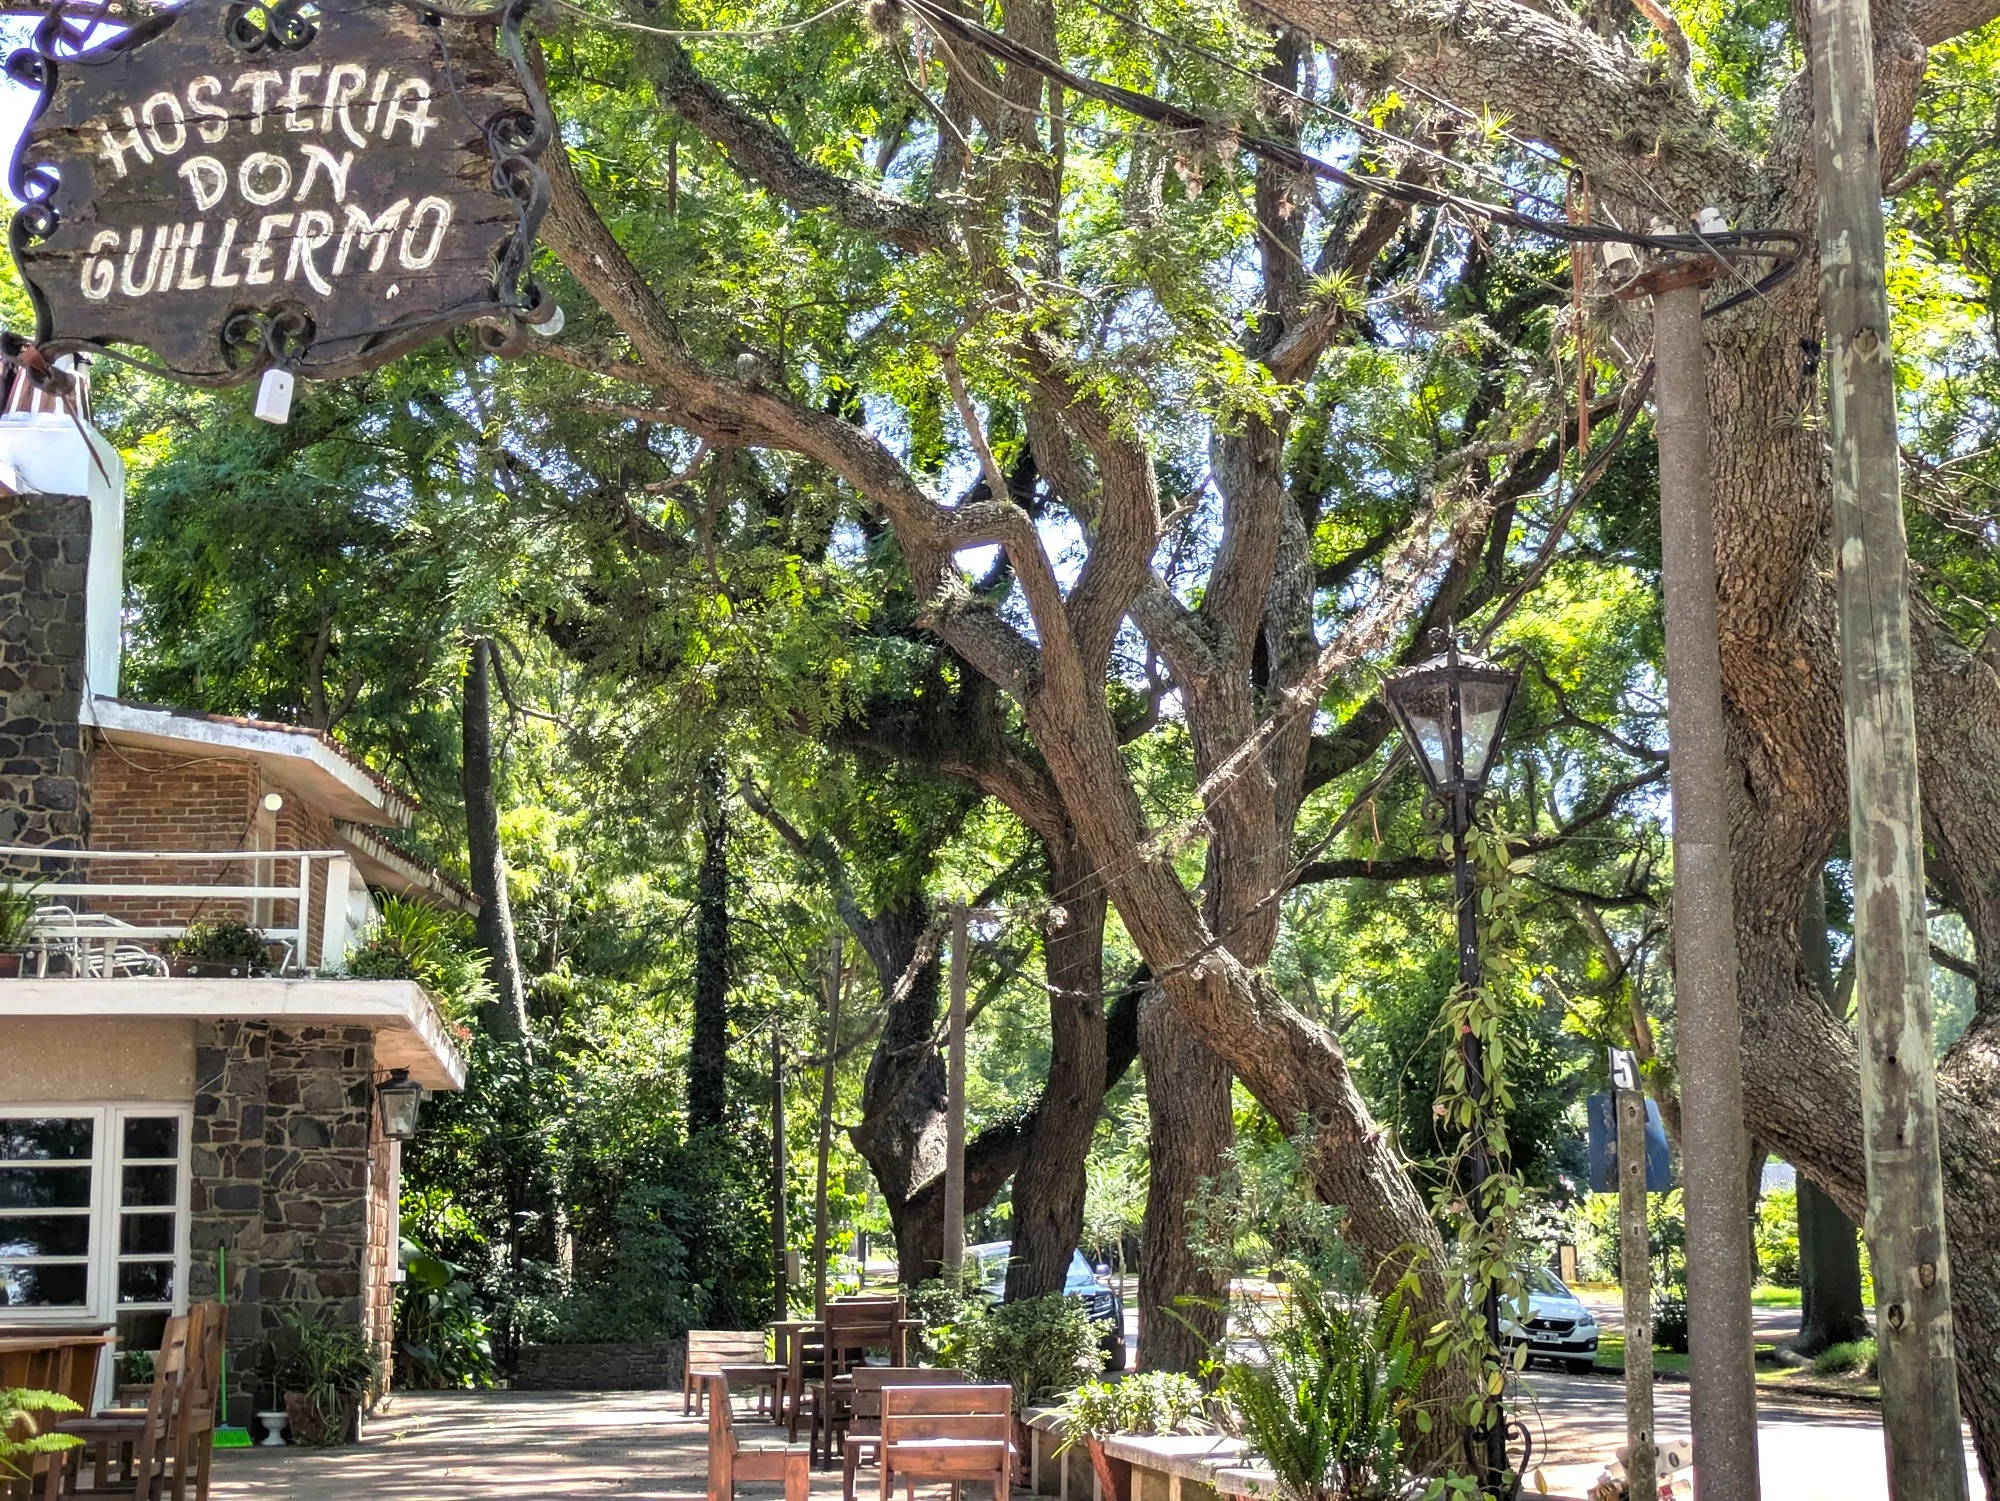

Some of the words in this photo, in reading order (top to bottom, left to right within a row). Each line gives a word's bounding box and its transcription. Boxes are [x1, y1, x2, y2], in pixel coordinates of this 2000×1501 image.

[98, 64, 439, 178] HOSTERIA
[179, 143, 354, 211] DON
[80, 196, 452, 299] GUILLERMO
